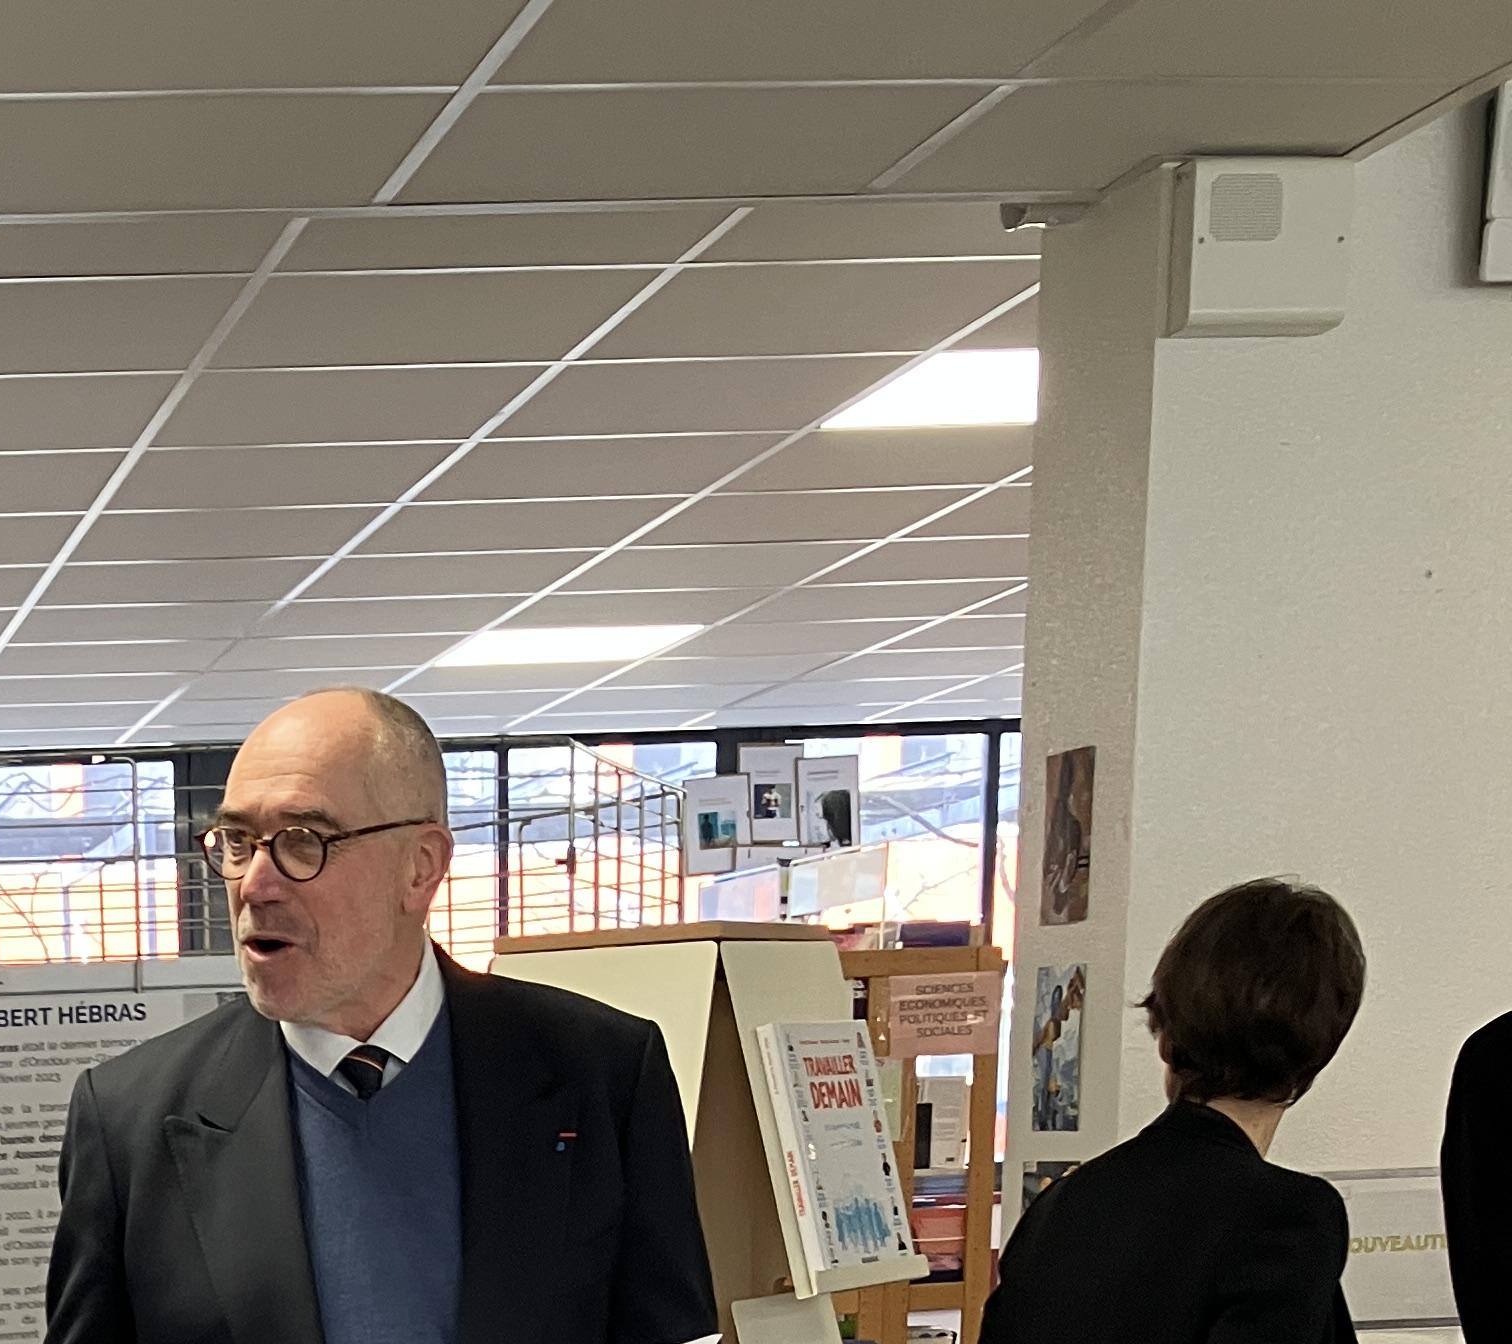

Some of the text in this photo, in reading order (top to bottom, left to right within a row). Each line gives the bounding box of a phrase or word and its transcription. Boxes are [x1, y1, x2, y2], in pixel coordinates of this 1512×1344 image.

[915, 982, 975, 995] SCIENCES
[58, 1001, 147, 1025] HÉBRAS
[916, 1024, 973, 1038] SOCIALES
[803, 1054, 857, 1077] TRAVAILLER
[810, 1078, 863, 1109] DEMAIN
[1349, 1232, 1446, 1254] OUVEAUT
